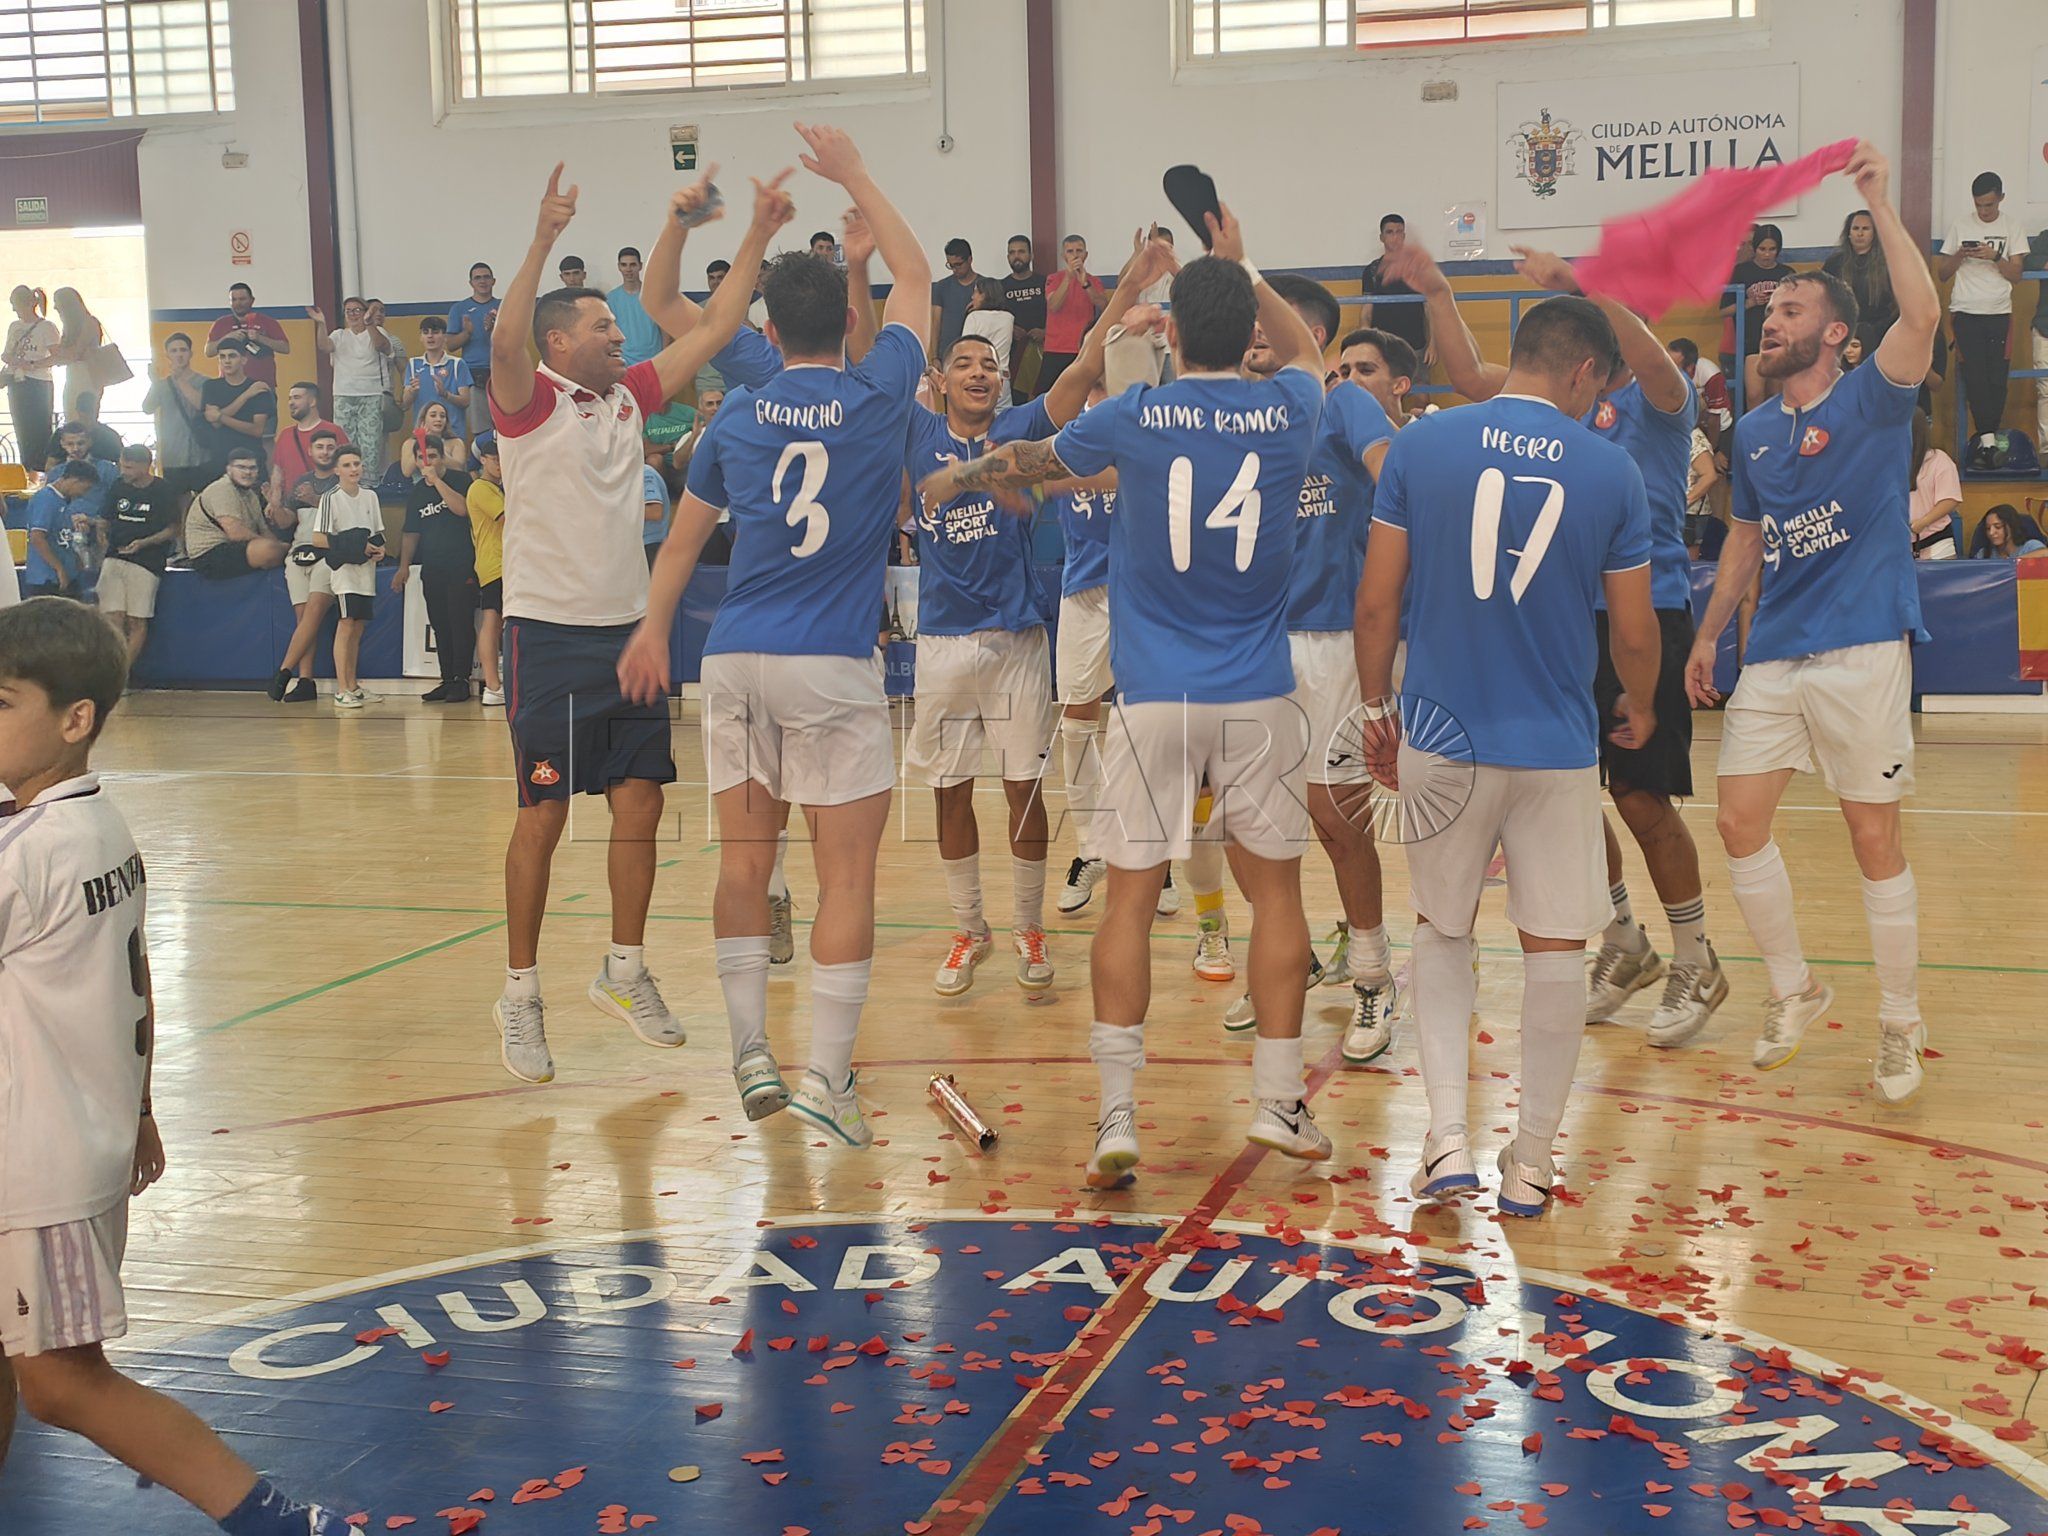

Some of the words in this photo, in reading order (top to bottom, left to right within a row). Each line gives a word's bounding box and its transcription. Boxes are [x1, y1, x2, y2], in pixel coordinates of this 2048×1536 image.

[1592, 121, 1662, 139] CIUDAD
[1668, 113, 1786, 136] AUTÓNOMA
[1594, 136, 1784, 181] MELILLA
[1609, 145, 1621, 153] DE
[18, 200, 46, 212] SALIDA
[1006, 287, 1041, 299] GUESS
[755, 398, 844, 430] GUANCHO
[1139, 405, 1207, 430] JAIME
[1214, 404, 1290, 434] RAMOS
[1482, 426, 1564, 462] NEGRO
[772, 440, 830, 558] 3
[944, 499, 994, 522] MELILLA
[1168, 451, 1261, 573] 14
[945, 514, 987, 533] SPORT
[1783, 499, 1843, 534] MELILLA
[947, 524, 998, 544] CAPITAL
[1471, 467, 1565, 606] 17
[1786, 518, 1834, 548] SPORT
[1791, 528, 1852, 559] CAPITAL
[228, 1244, 942, 1381] CIUDAD
